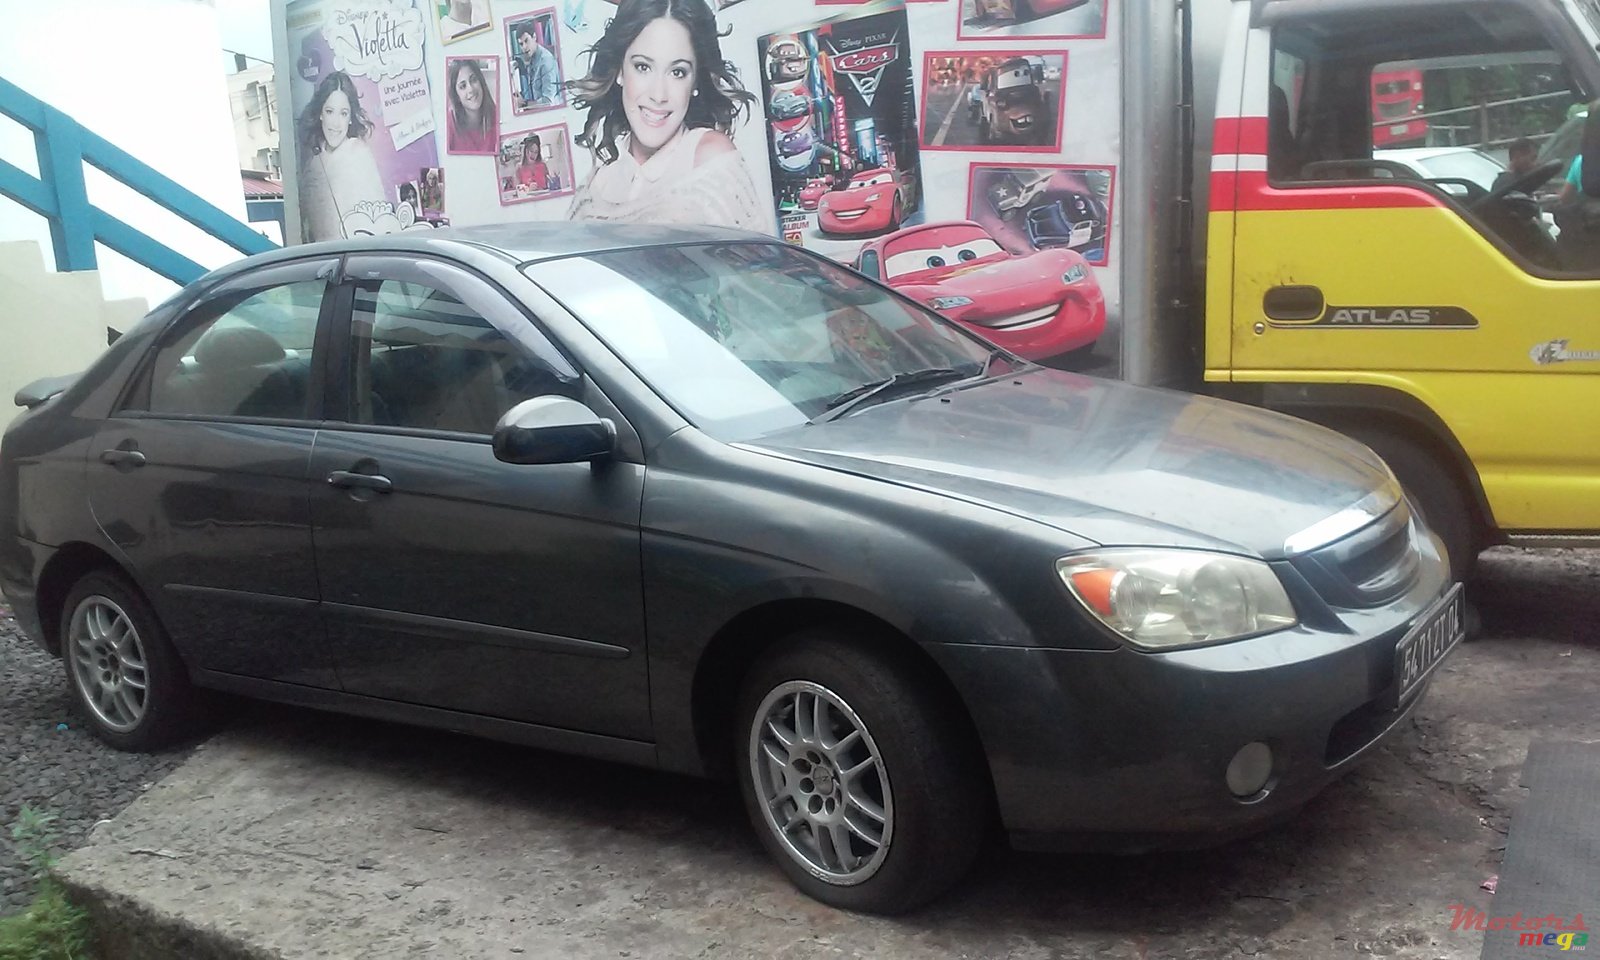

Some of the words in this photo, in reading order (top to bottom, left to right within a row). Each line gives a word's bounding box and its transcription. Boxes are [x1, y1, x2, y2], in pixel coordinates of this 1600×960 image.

[336, 16, 413, 65] Violetta
[839, 38, 862, 49] Disney
[865, 32, 887, 43] PIXAR
[839, 51, 891, 69] Cars
[860, 76, 876, 94] 2
[783, 220, 810, 231] ALBUM
[1331, 309, 1430, 324] ATLAS
[1433, 613, 1446, 658] ZT
[1448, 599, 1460, 642] 04
